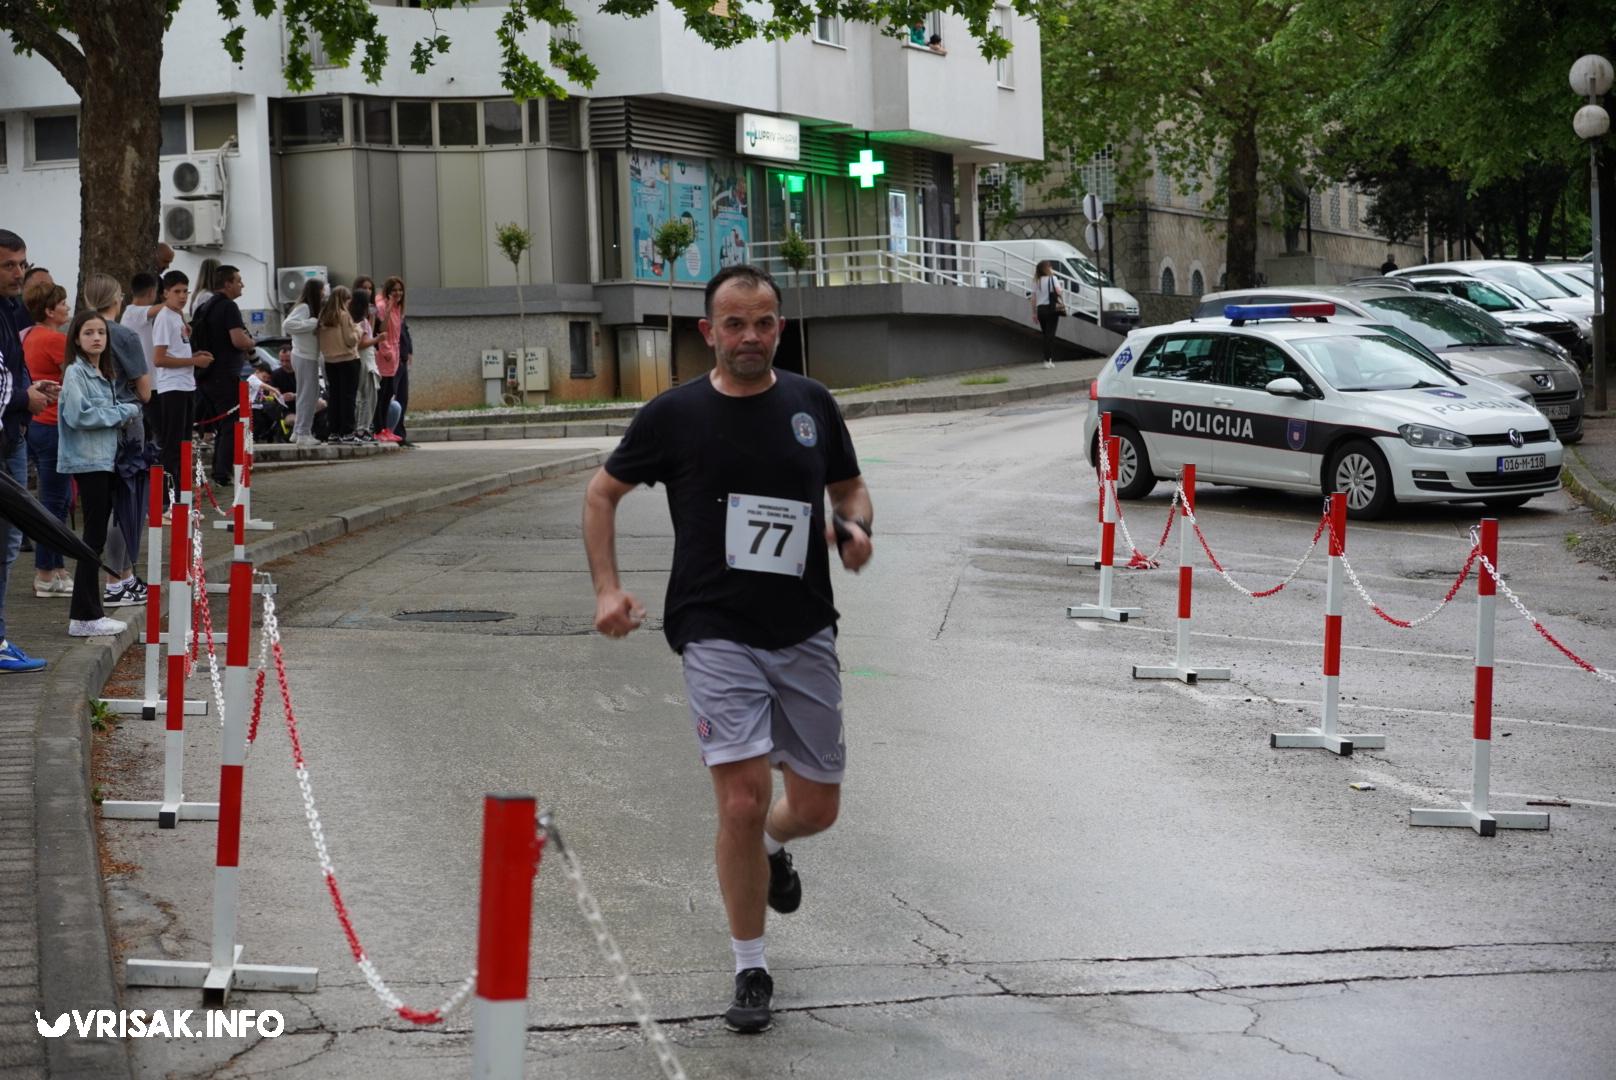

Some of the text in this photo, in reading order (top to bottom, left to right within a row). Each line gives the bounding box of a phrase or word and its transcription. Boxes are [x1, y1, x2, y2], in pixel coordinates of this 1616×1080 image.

[1433, 400, 1526, 414] POLICIJA
[1171, 409, 1254, 439] POLICIJA
[1504, 456, 1545, 471] 016-M-118
[748, 520, 793, 557] 77
